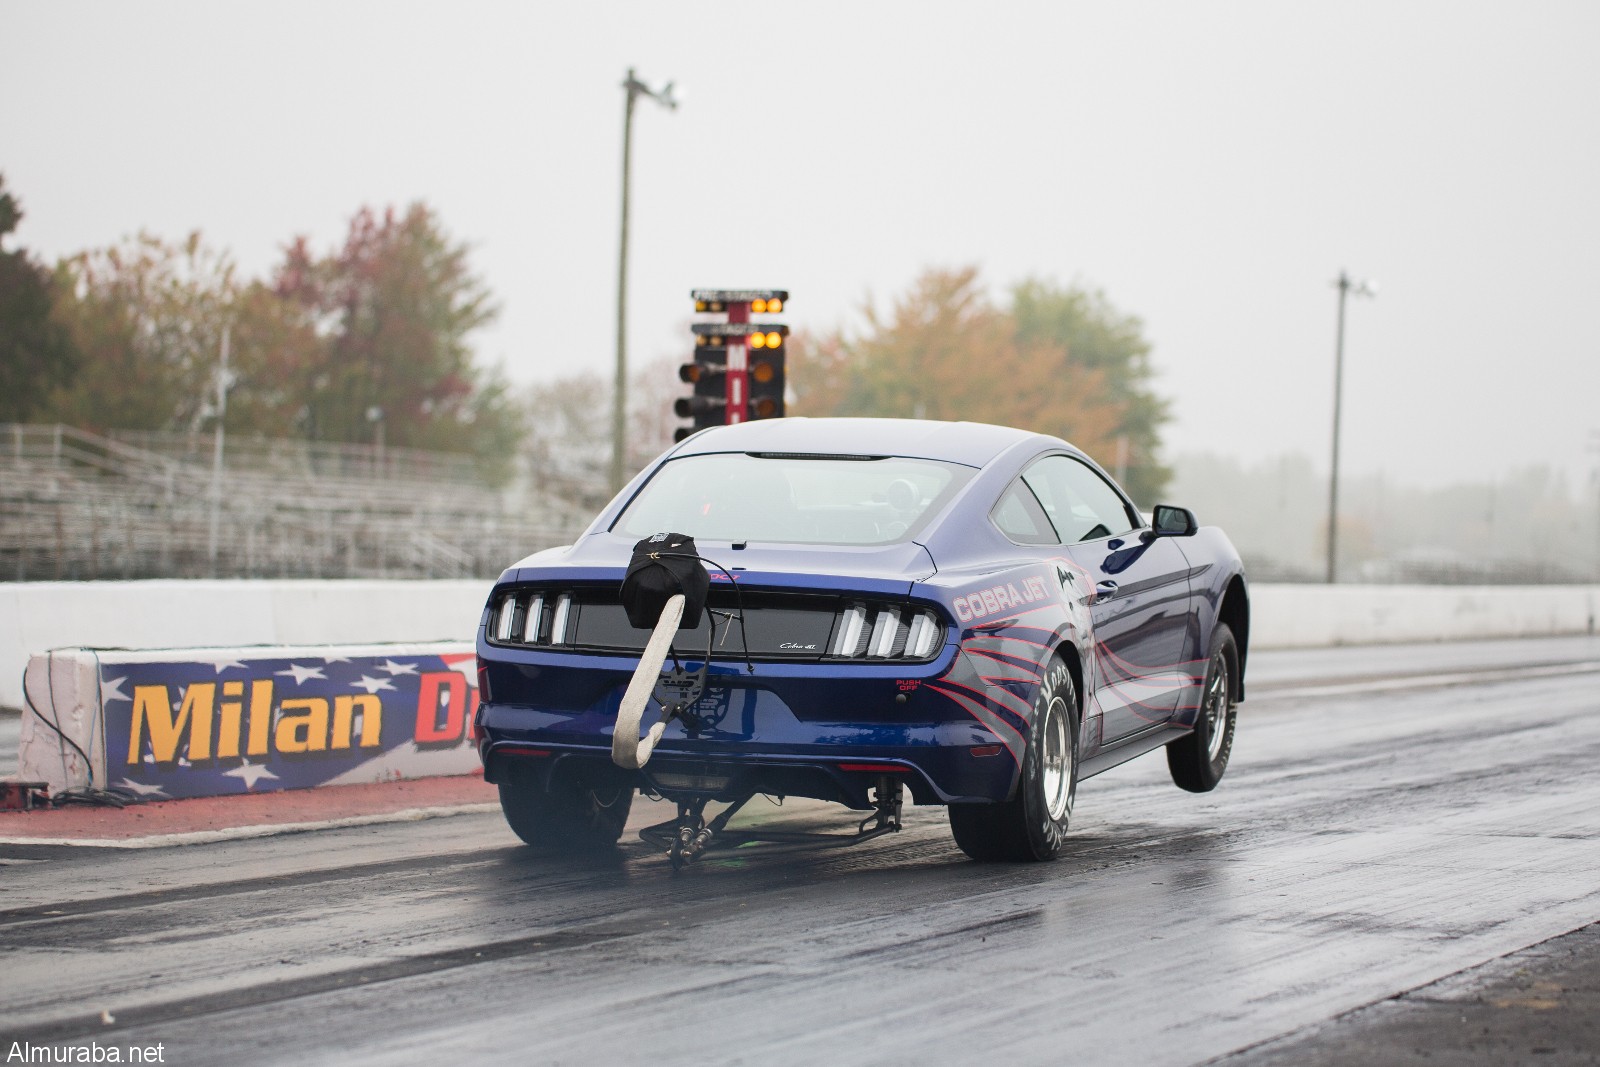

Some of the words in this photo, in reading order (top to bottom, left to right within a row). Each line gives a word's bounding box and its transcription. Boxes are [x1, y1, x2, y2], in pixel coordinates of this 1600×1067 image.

[953, 582, 1025, 623] COBRA
[1022, 576, 1051, 603] JET
[127, 679, 383, 765] Milan
